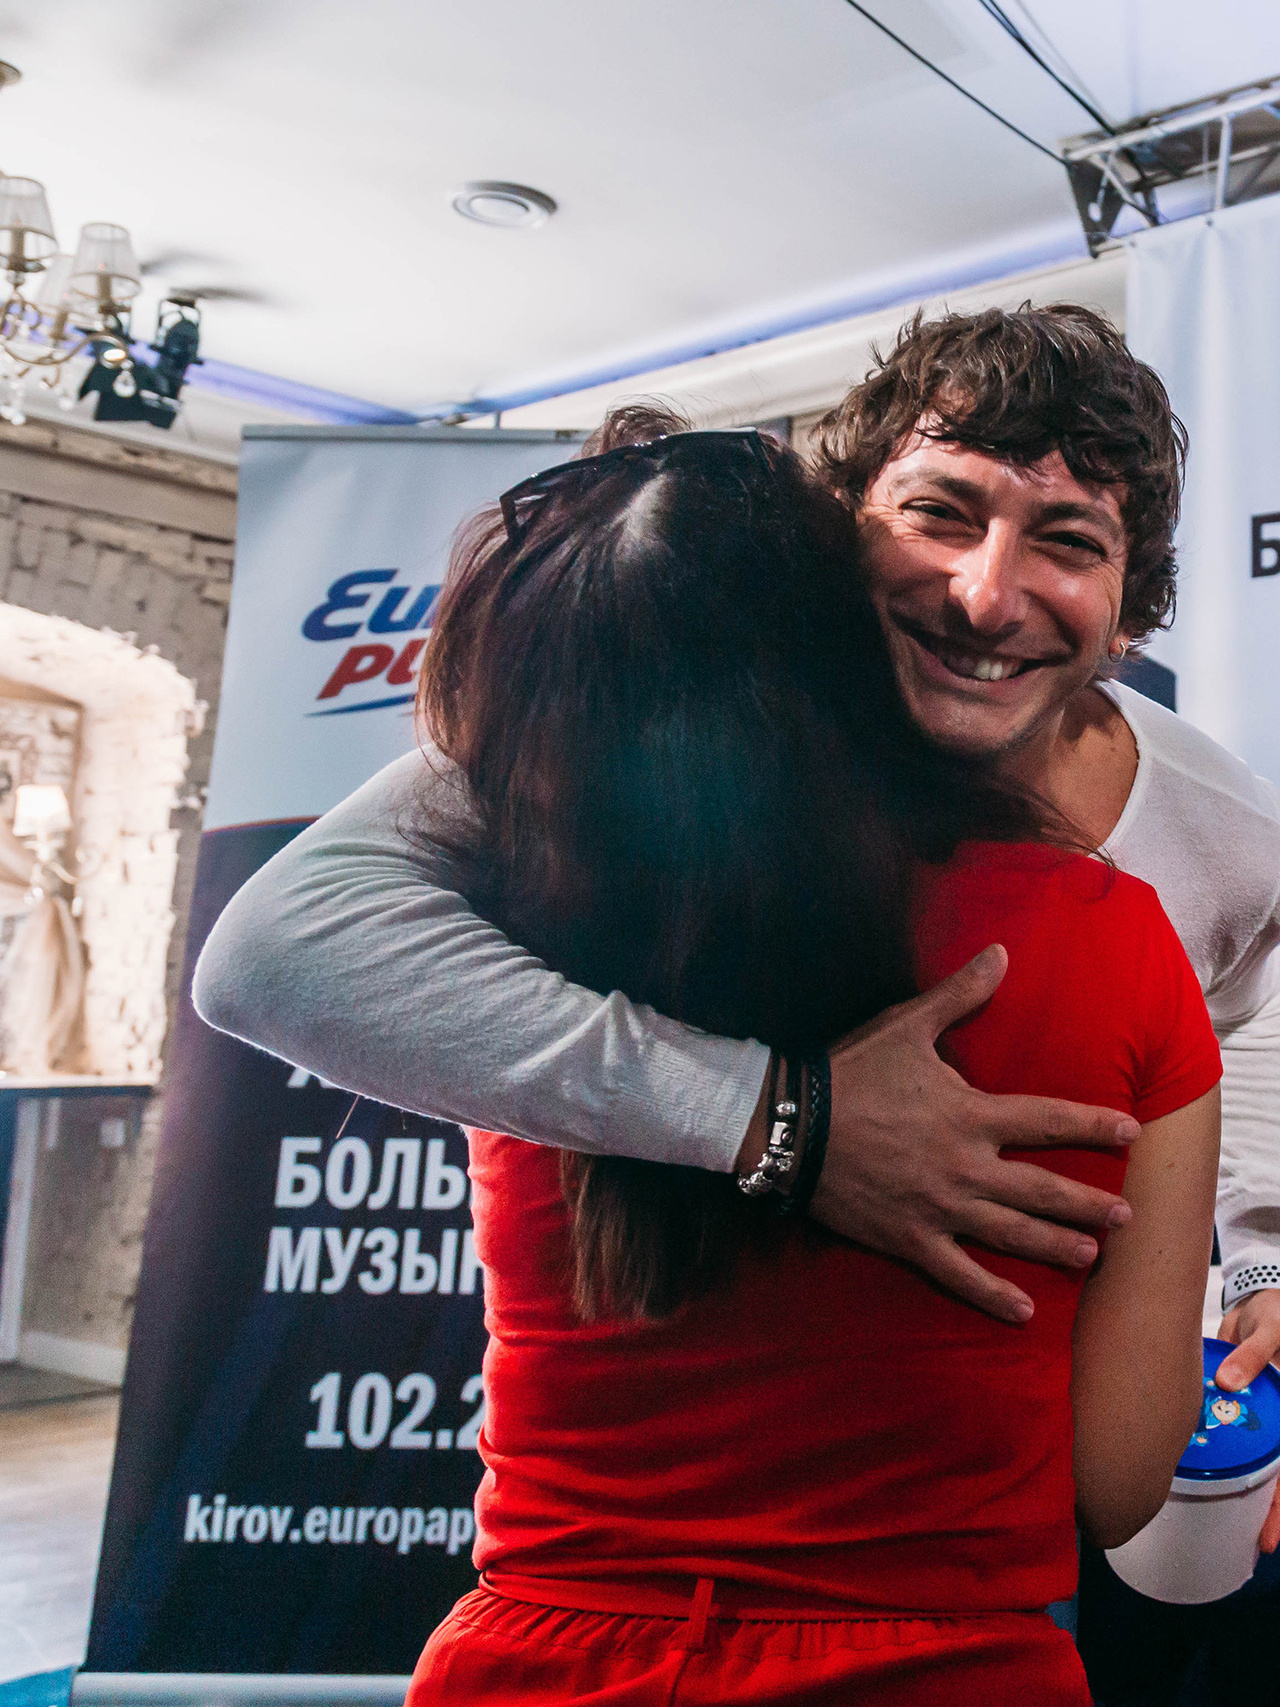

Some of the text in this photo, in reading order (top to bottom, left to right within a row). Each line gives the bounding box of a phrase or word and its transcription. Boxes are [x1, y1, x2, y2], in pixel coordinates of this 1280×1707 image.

[301, 567, 442, 642] Eu
[274, 1135, 474, 1211] БОЛЬ
[184, 1493, 476, 1555] kirov.europap
